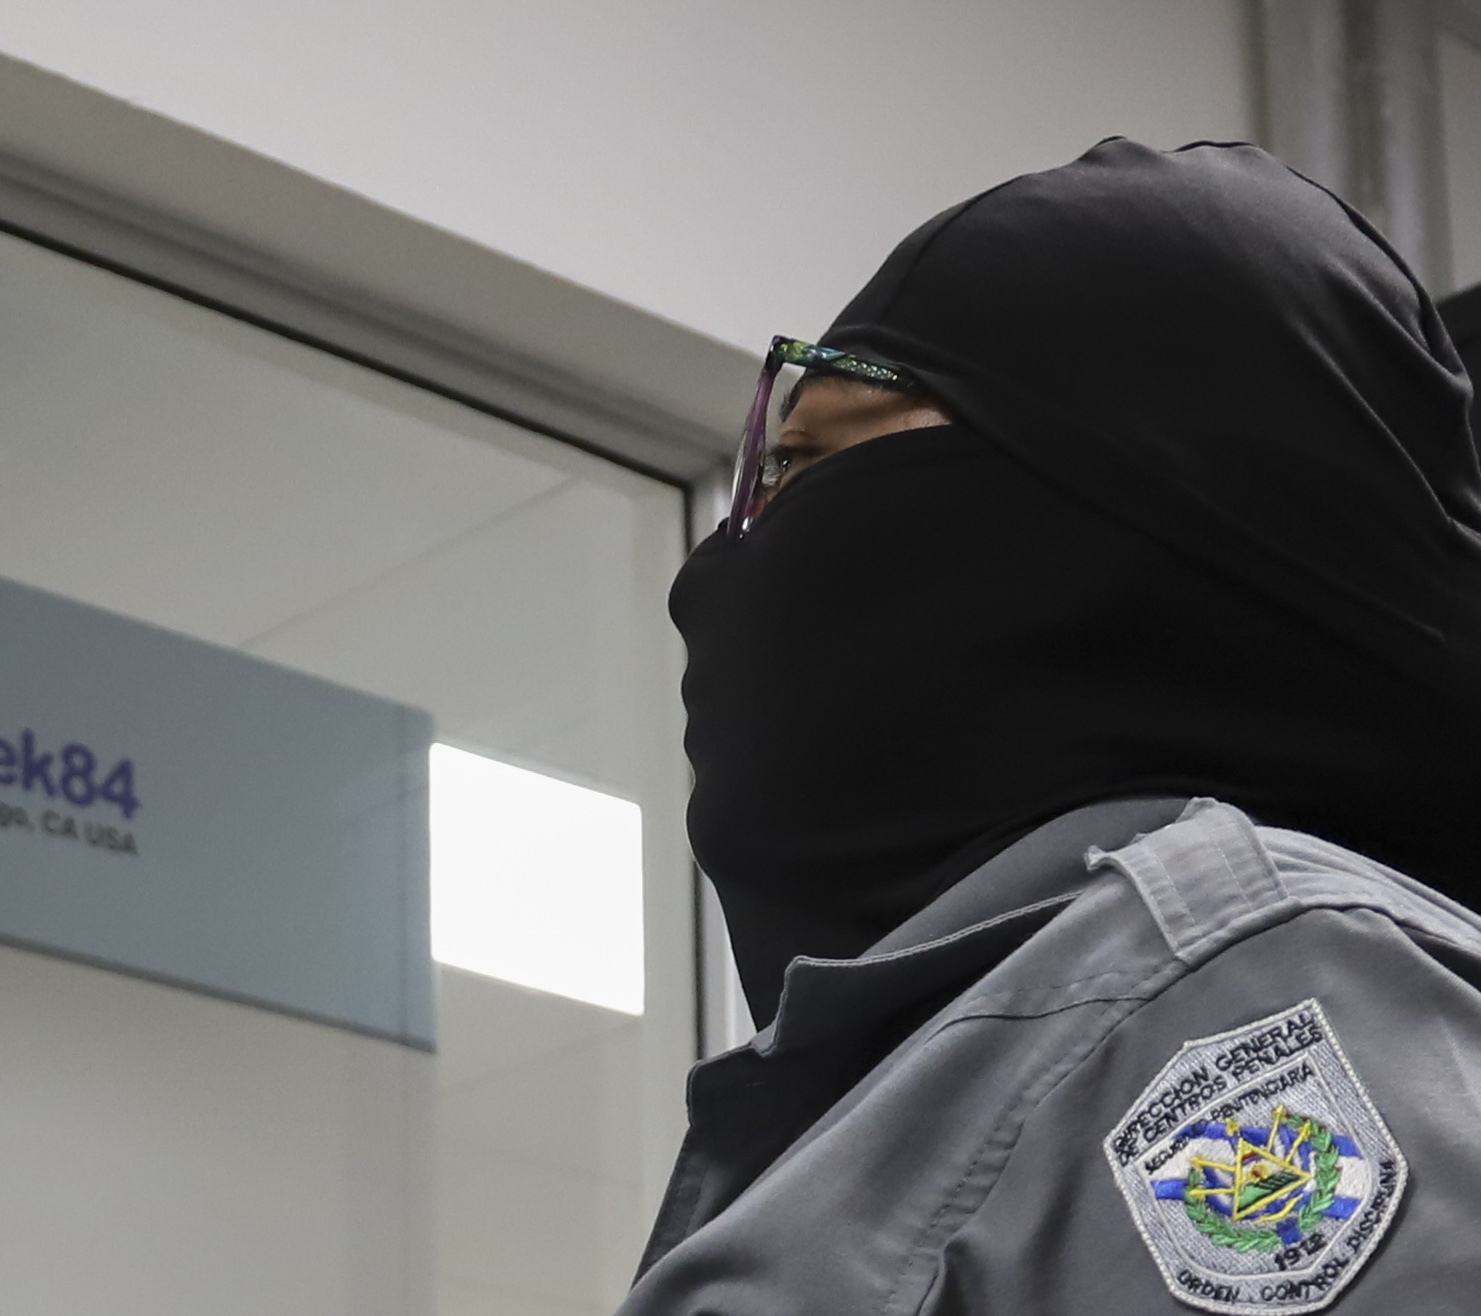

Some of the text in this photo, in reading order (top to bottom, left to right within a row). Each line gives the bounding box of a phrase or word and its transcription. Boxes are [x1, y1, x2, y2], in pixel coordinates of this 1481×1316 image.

[40, 809, 80, 841] CA
[83, 822, 139, 856] USA
[1113, 1014, 1317, 1152] DIRECCION GENERAL
[1142, 1075, 1227, 1143] CENTROS
[1231, 1030, 1322, 1081] PENALES
[1177, 1268, 1239, 1303] ORDEN
[1260, 1258, 1350, 1301] CONTROL
